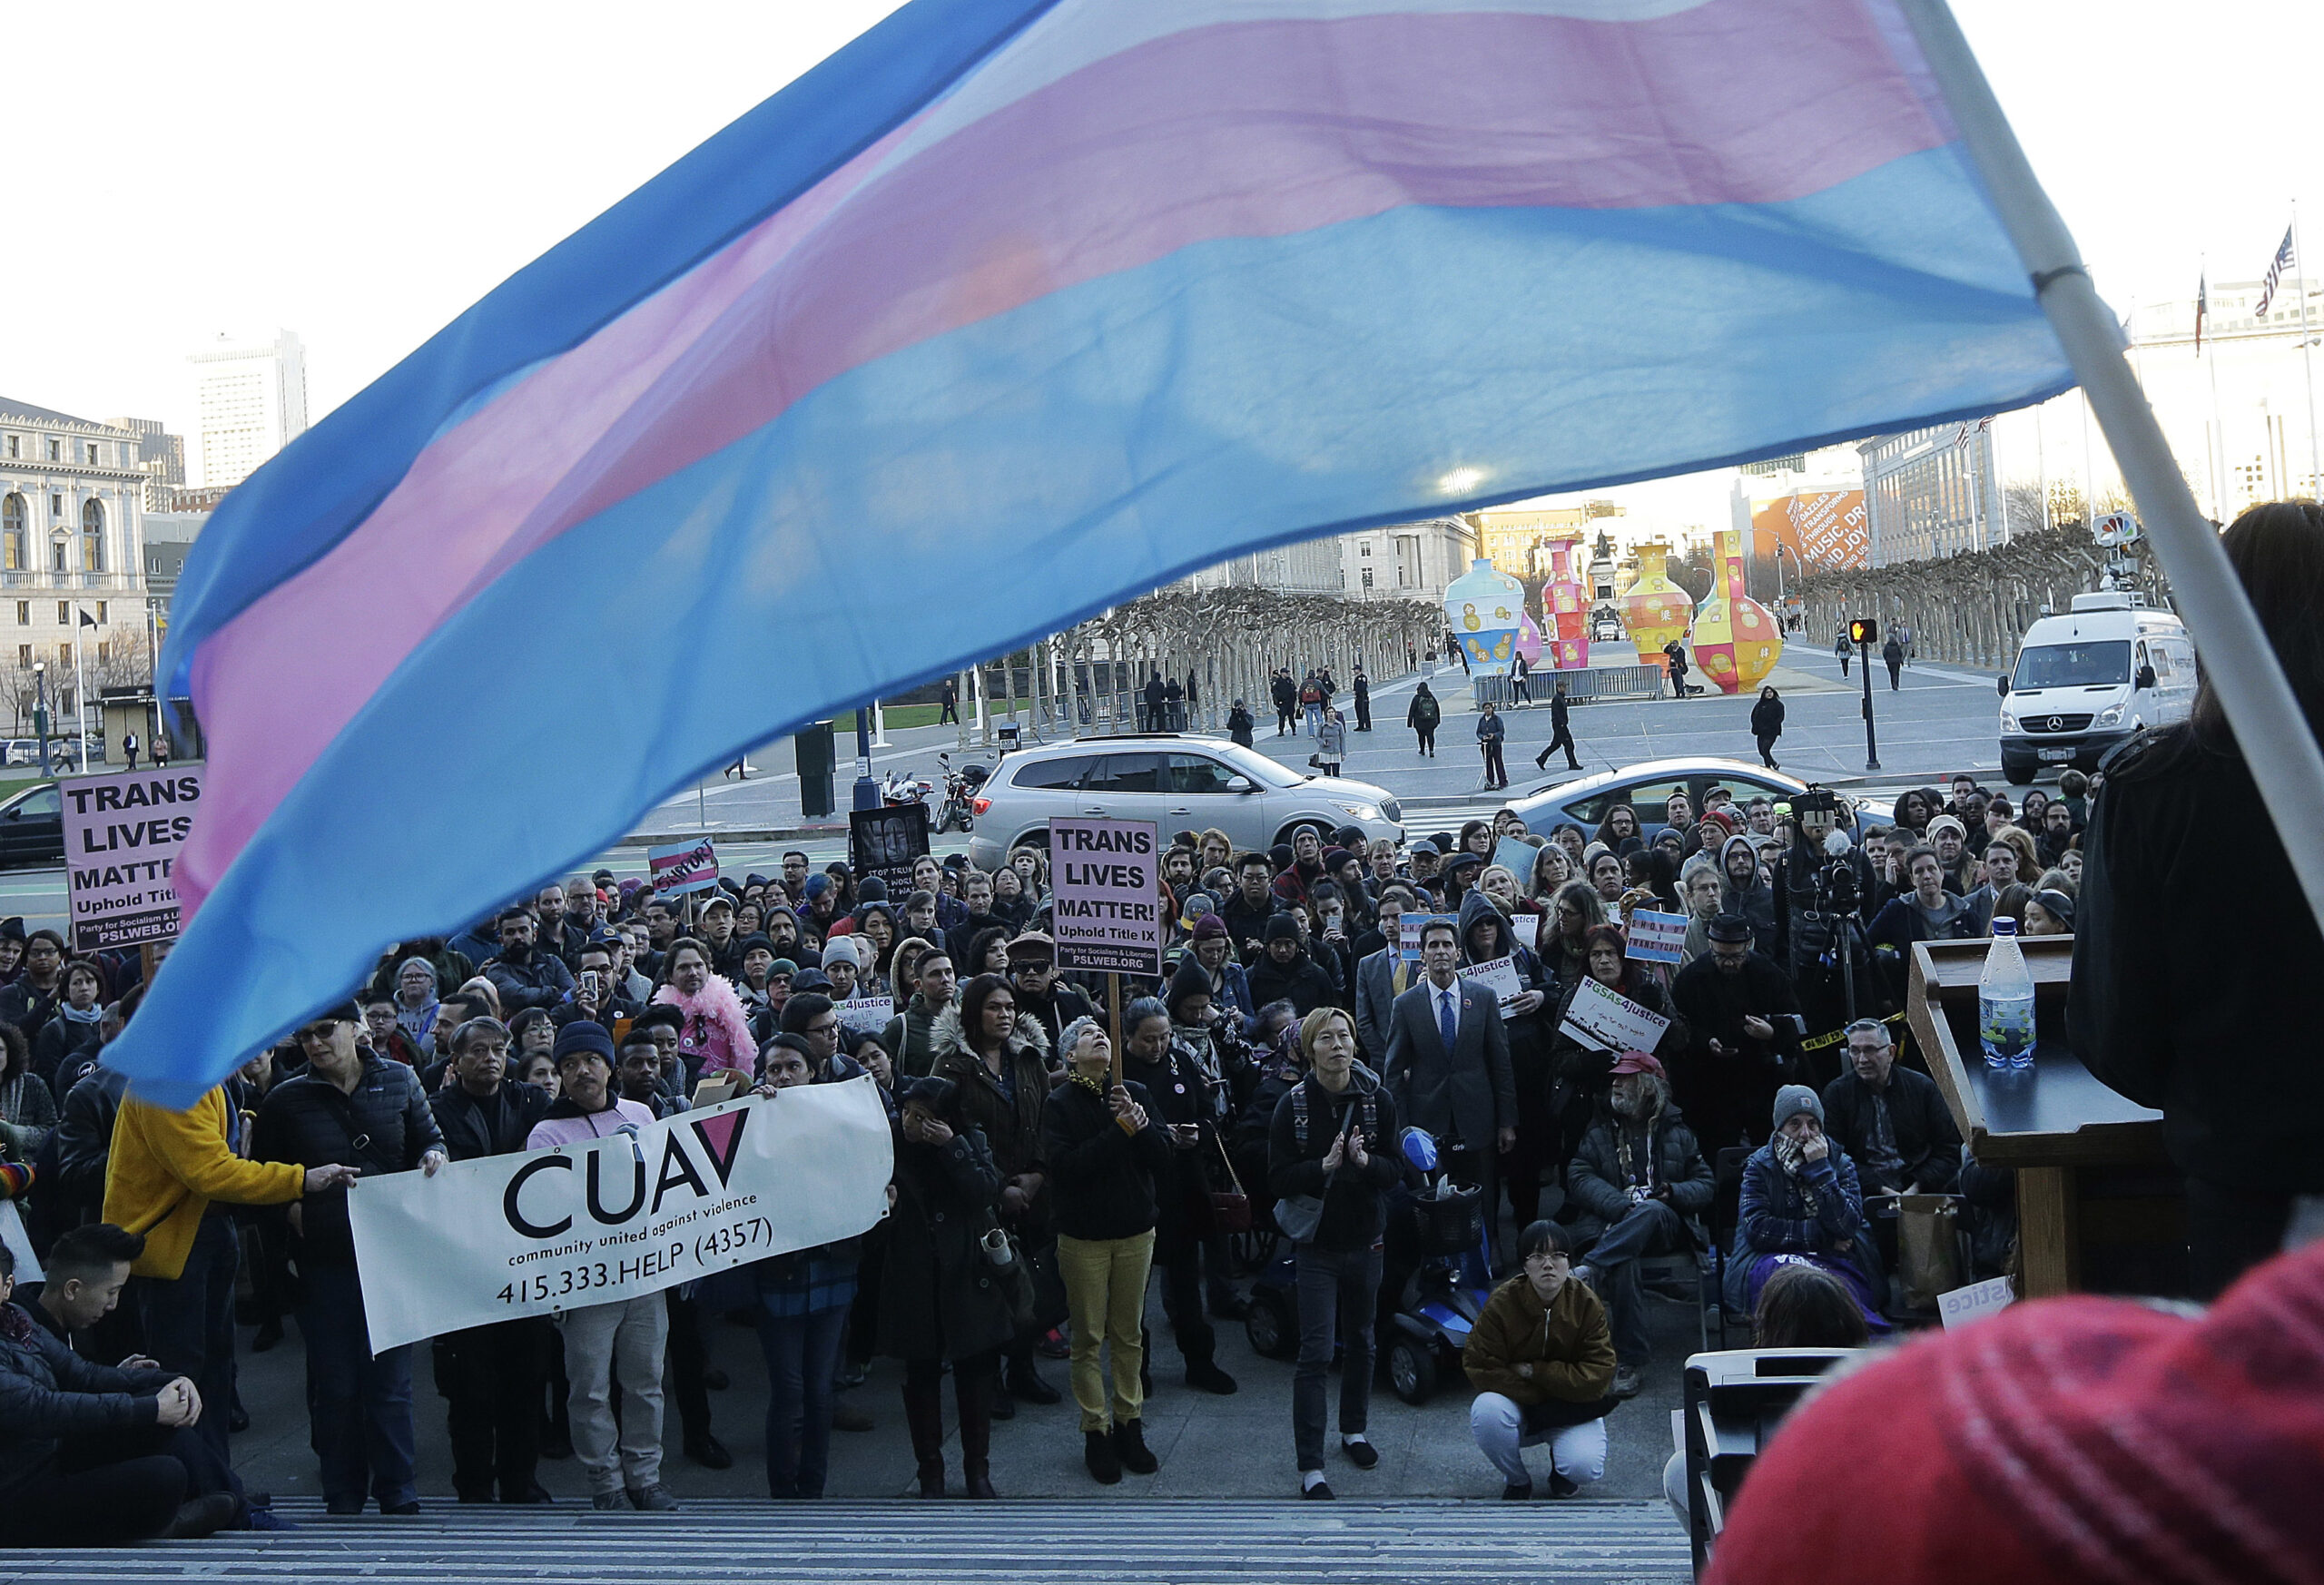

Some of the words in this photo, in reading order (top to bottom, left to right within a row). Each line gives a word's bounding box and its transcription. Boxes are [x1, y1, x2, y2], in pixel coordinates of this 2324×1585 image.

[1804, 490, 1849, 530] TRANSFORMS
[1806, 512, 1837, 542] THROUGH
[1845, 526, 1866, 552] JOY
[1804, 526, 1849, 564] MUSIC,
[67, 777, 201, 814] TRANS
[84, 816, 192, 853] LIVES
[1056, 829, 1151, 855] TRANS
[657, 837, 714, 892] SUPPORT
[868, 868, 888, 877] STOP
[1066, 863, 1145, 889] LIVES
[891, 877, 911, 887] WORL
[77, 893, 143, 914] Uphold
[148, 888, 177, 903] Titl
[1058, 899, 1155, 921] MATTER!
[79, 923, 103, 934] Party
[105, 920, 118, 930] for
[119, 914, 162, 928] Socialism
[162, 911, 170, 920] &
[99, 920, 180, 943] PSLWEB.O
[1059, 925, 1106, 940] Uphold
[1108, 928, 1138, 940] Title
[1142, 930, 1156, 942] IX
[1632, 920, 1664, 931] SHOW
[1059, 946, 1077, 955] Party
[1078, 946, 1087, 954] for
[1088, 947, 1118, 956] Socialism
[1126, 950, 1156, 960] Liberation
[1660, 944, 1682, 953] YOUTH
[1073, 955, 1144, 970] PSLWEB.ORG
[1461, 959, 1510, 979] s4Justice
[833, 998, 891, 1010] As4Justice
[1584, 979, 1666, 1028] #GSAs4Justice
[503, 1107, 751, 1238] CUAV
[508, 1240, 593, 1266] community
[599, 1226, 647, 1246] united
[652, 1209, 698, 1236] against
[703, 1194, 757, 1217] violence
[497, 1243, 684, 1304] 415.333.HELP
[694, 1216, 773, 1266] (4357)
